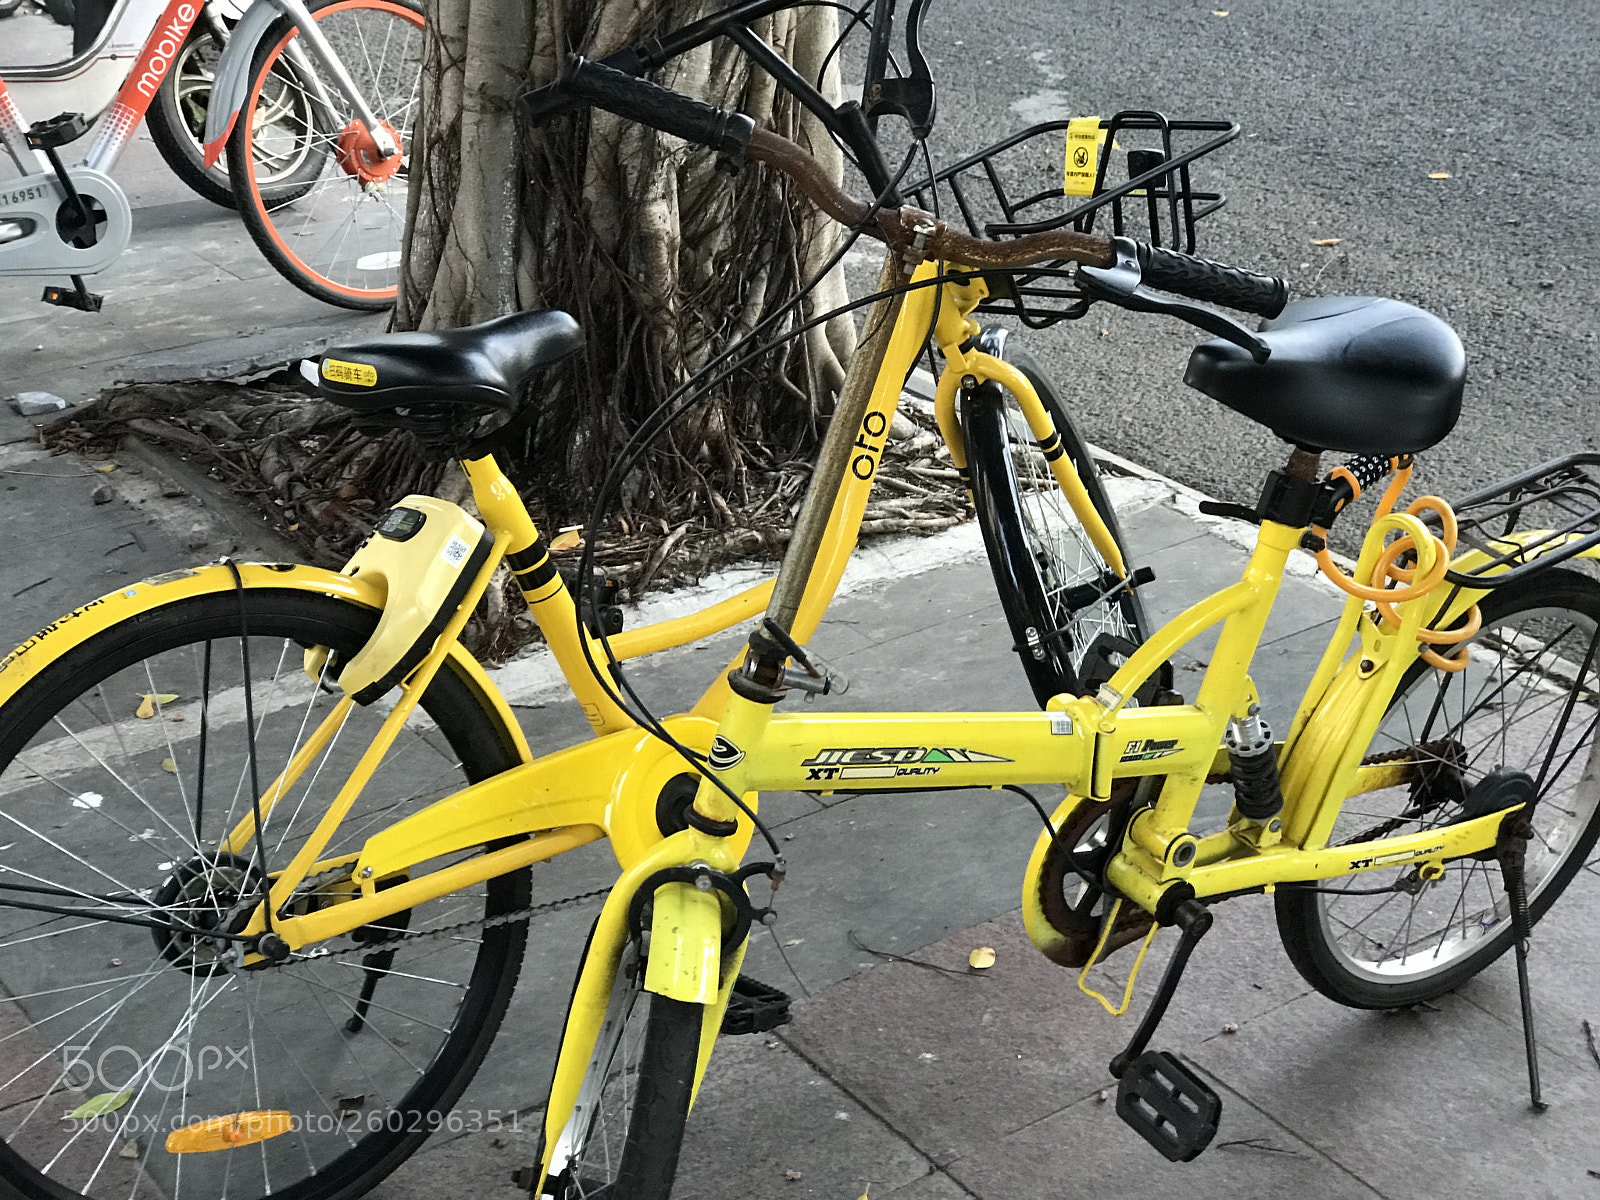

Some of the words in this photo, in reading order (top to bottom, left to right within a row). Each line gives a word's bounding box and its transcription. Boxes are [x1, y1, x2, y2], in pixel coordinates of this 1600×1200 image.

[136, 3, 195, 97] mobike
[0, 187, 42, 206] 16951
[852, 411, 887, 480] ofo
[806, 768, 840, 780] XT
[896, 767, 940, 776] QUALITY
[1349, 858, 1374, 870] XT
